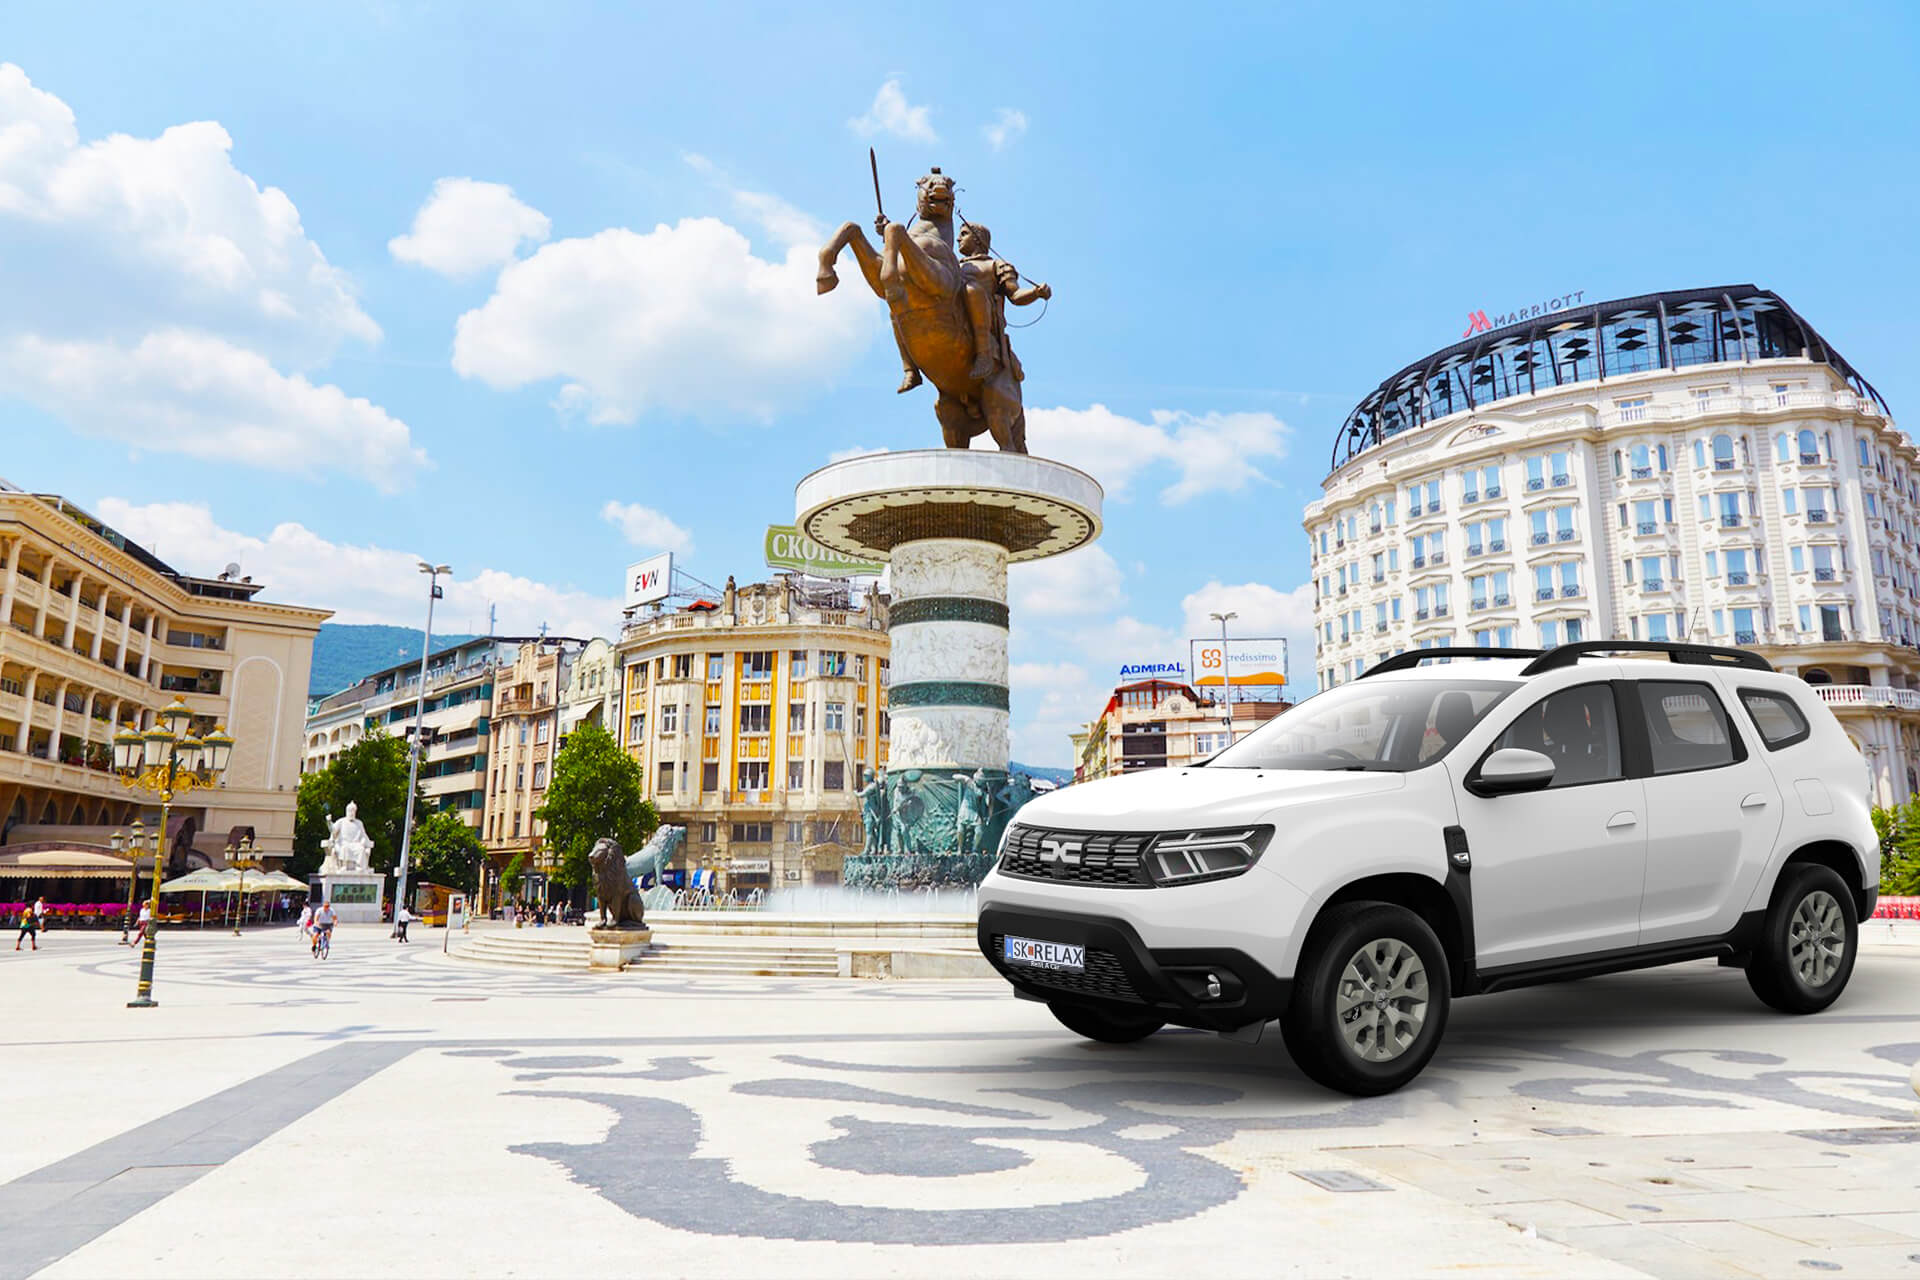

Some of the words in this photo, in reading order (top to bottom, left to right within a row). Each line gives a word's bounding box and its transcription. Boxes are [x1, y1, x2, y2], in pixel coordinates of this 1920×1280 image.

[1494, 290, 1584, 328] MARRIOTT
[634, 568, 659, 592] EVN
[1120, 662, 1185, 675] ADMIRAL
[1034, 944, 1083, 965] RELAX
